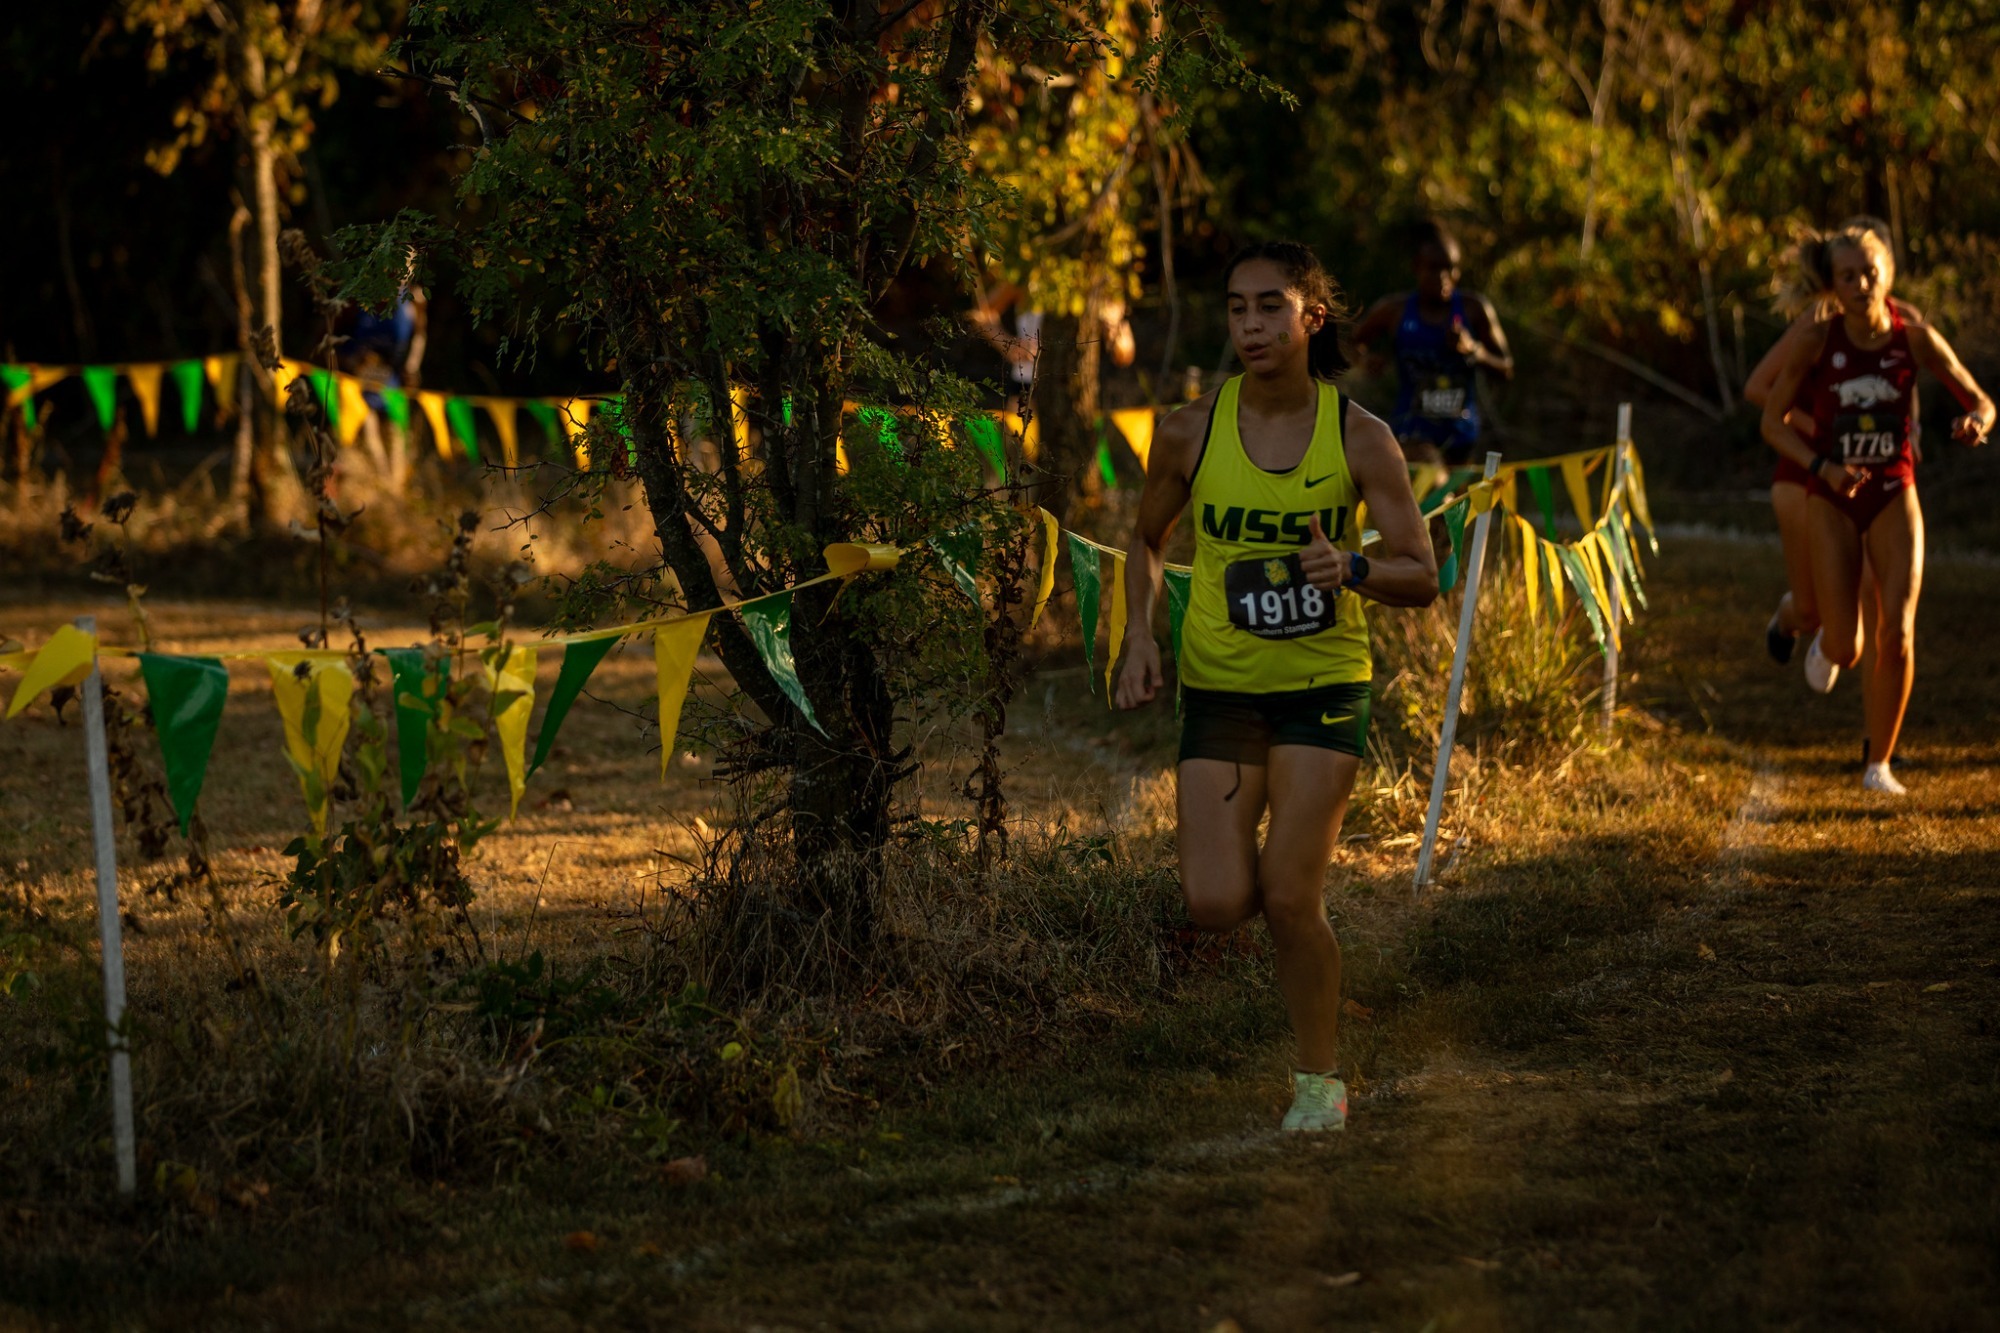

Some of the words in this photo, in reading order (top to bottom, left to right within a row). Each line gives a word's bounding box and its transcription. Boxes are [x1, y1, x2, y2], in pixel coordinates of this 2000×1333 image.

[1839, 431, 1895, 457] 1776
[1203, 504, 1346, 544] MSSU
[1239, 584, 1325, 626] 1918
